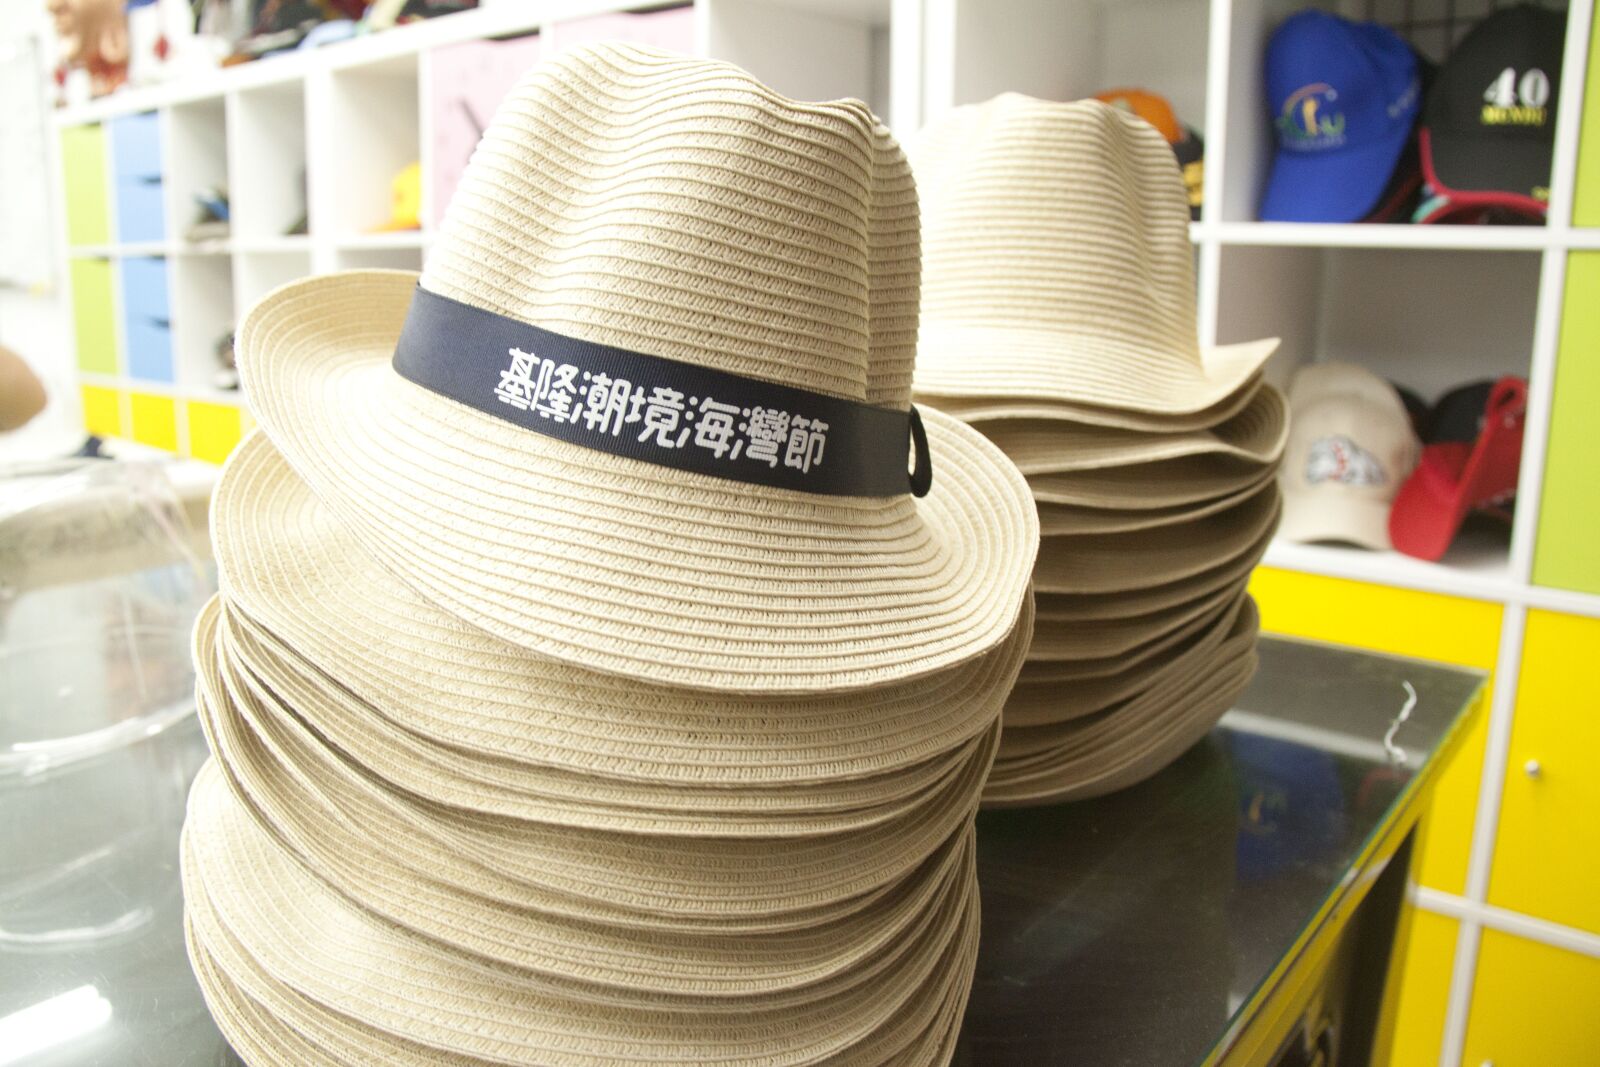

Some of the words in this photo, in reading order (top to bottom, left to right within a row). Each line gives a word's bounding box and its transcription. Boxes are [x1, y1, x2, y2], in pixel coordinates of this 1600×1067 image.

[1483, 67, 1550, 107] 40
[494, 348, 830, 474] 基隆潮境海灣節
